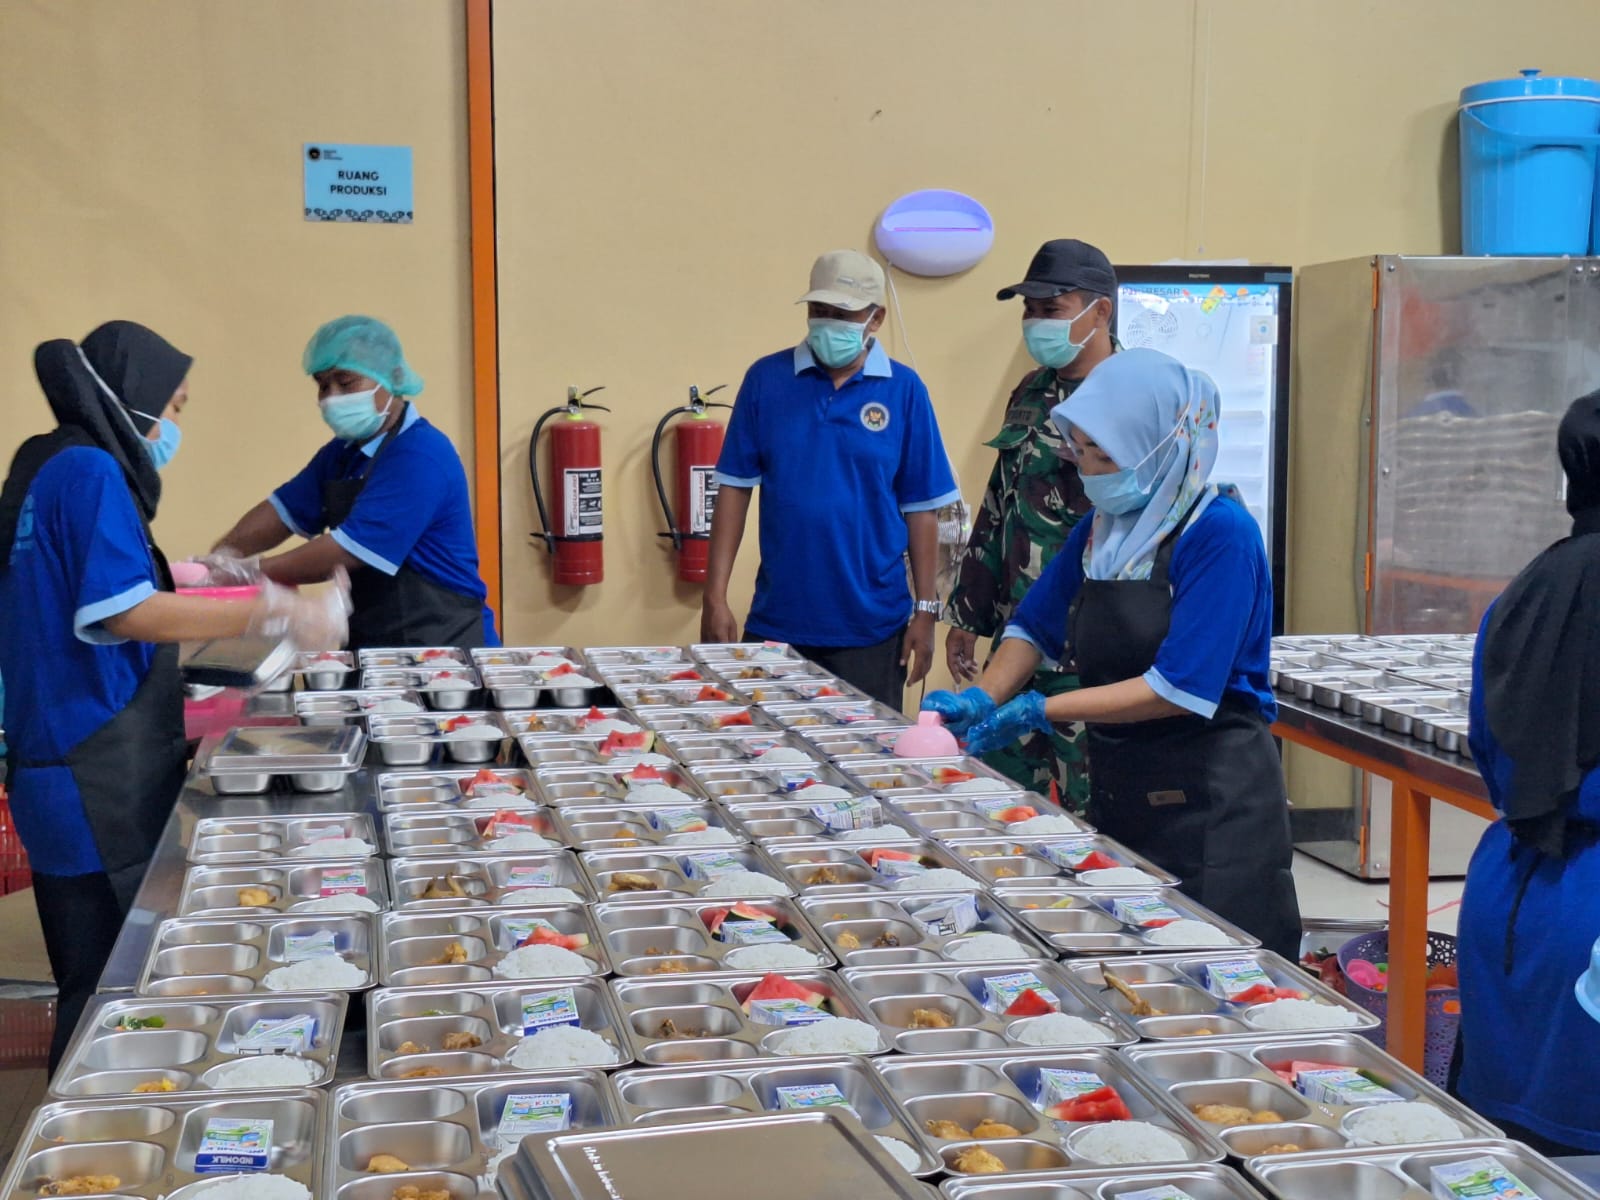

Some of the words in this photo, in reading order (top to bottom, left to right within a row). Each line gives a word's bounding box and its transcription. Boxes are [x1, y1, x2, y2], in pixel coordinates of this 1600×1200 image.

[338, 170, 379, 181] RUANG
[330, 184, 387, 196] PRODUKSI
[212, 1155, 254, 1165] INDOMILK
